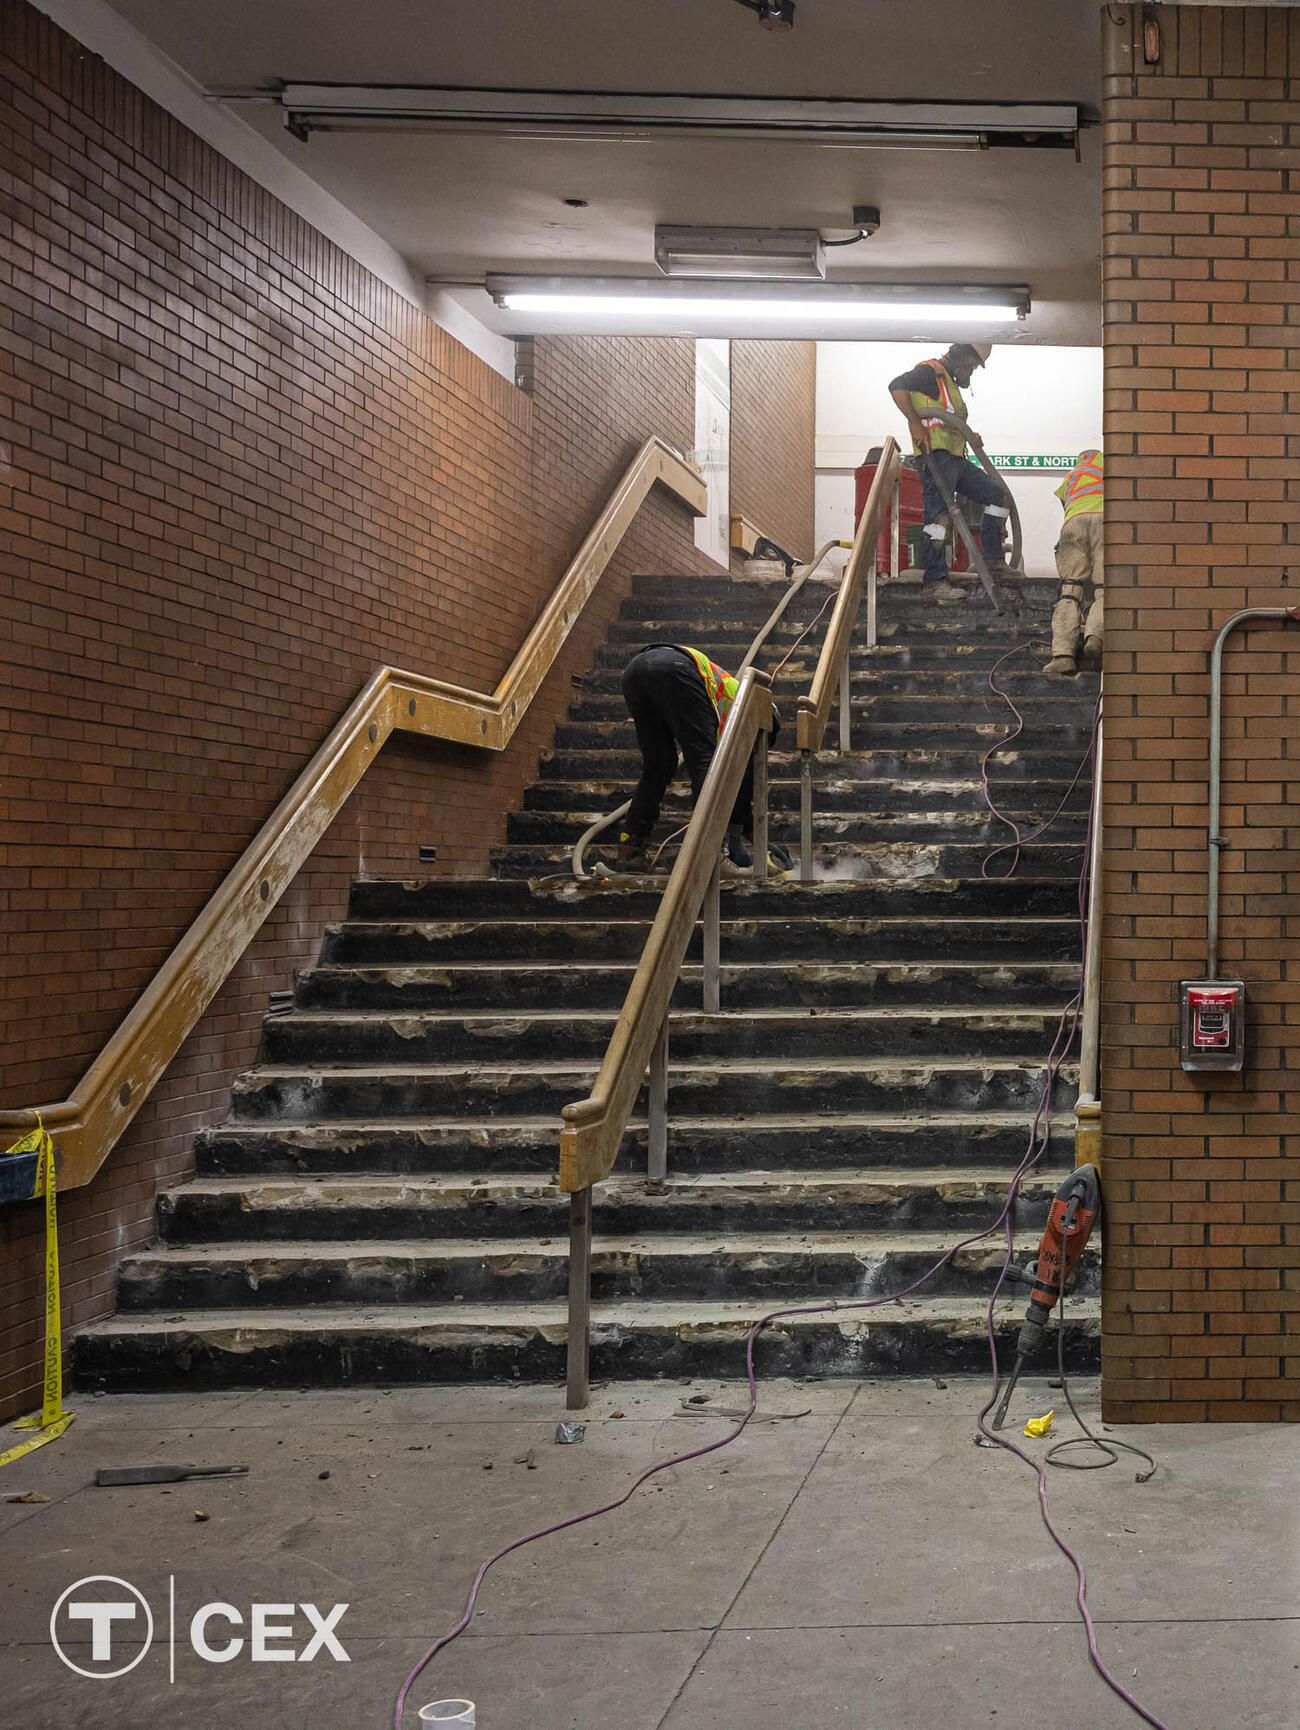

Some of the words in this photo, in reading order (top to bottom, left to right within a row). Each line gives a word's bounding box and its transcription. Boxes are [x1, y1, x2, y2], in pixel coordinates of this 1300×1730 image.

[1014, 456, 1030, 466] ST
[1032, 456, 1040, 466] &
[1043, 456, 1077, 466] NORT
